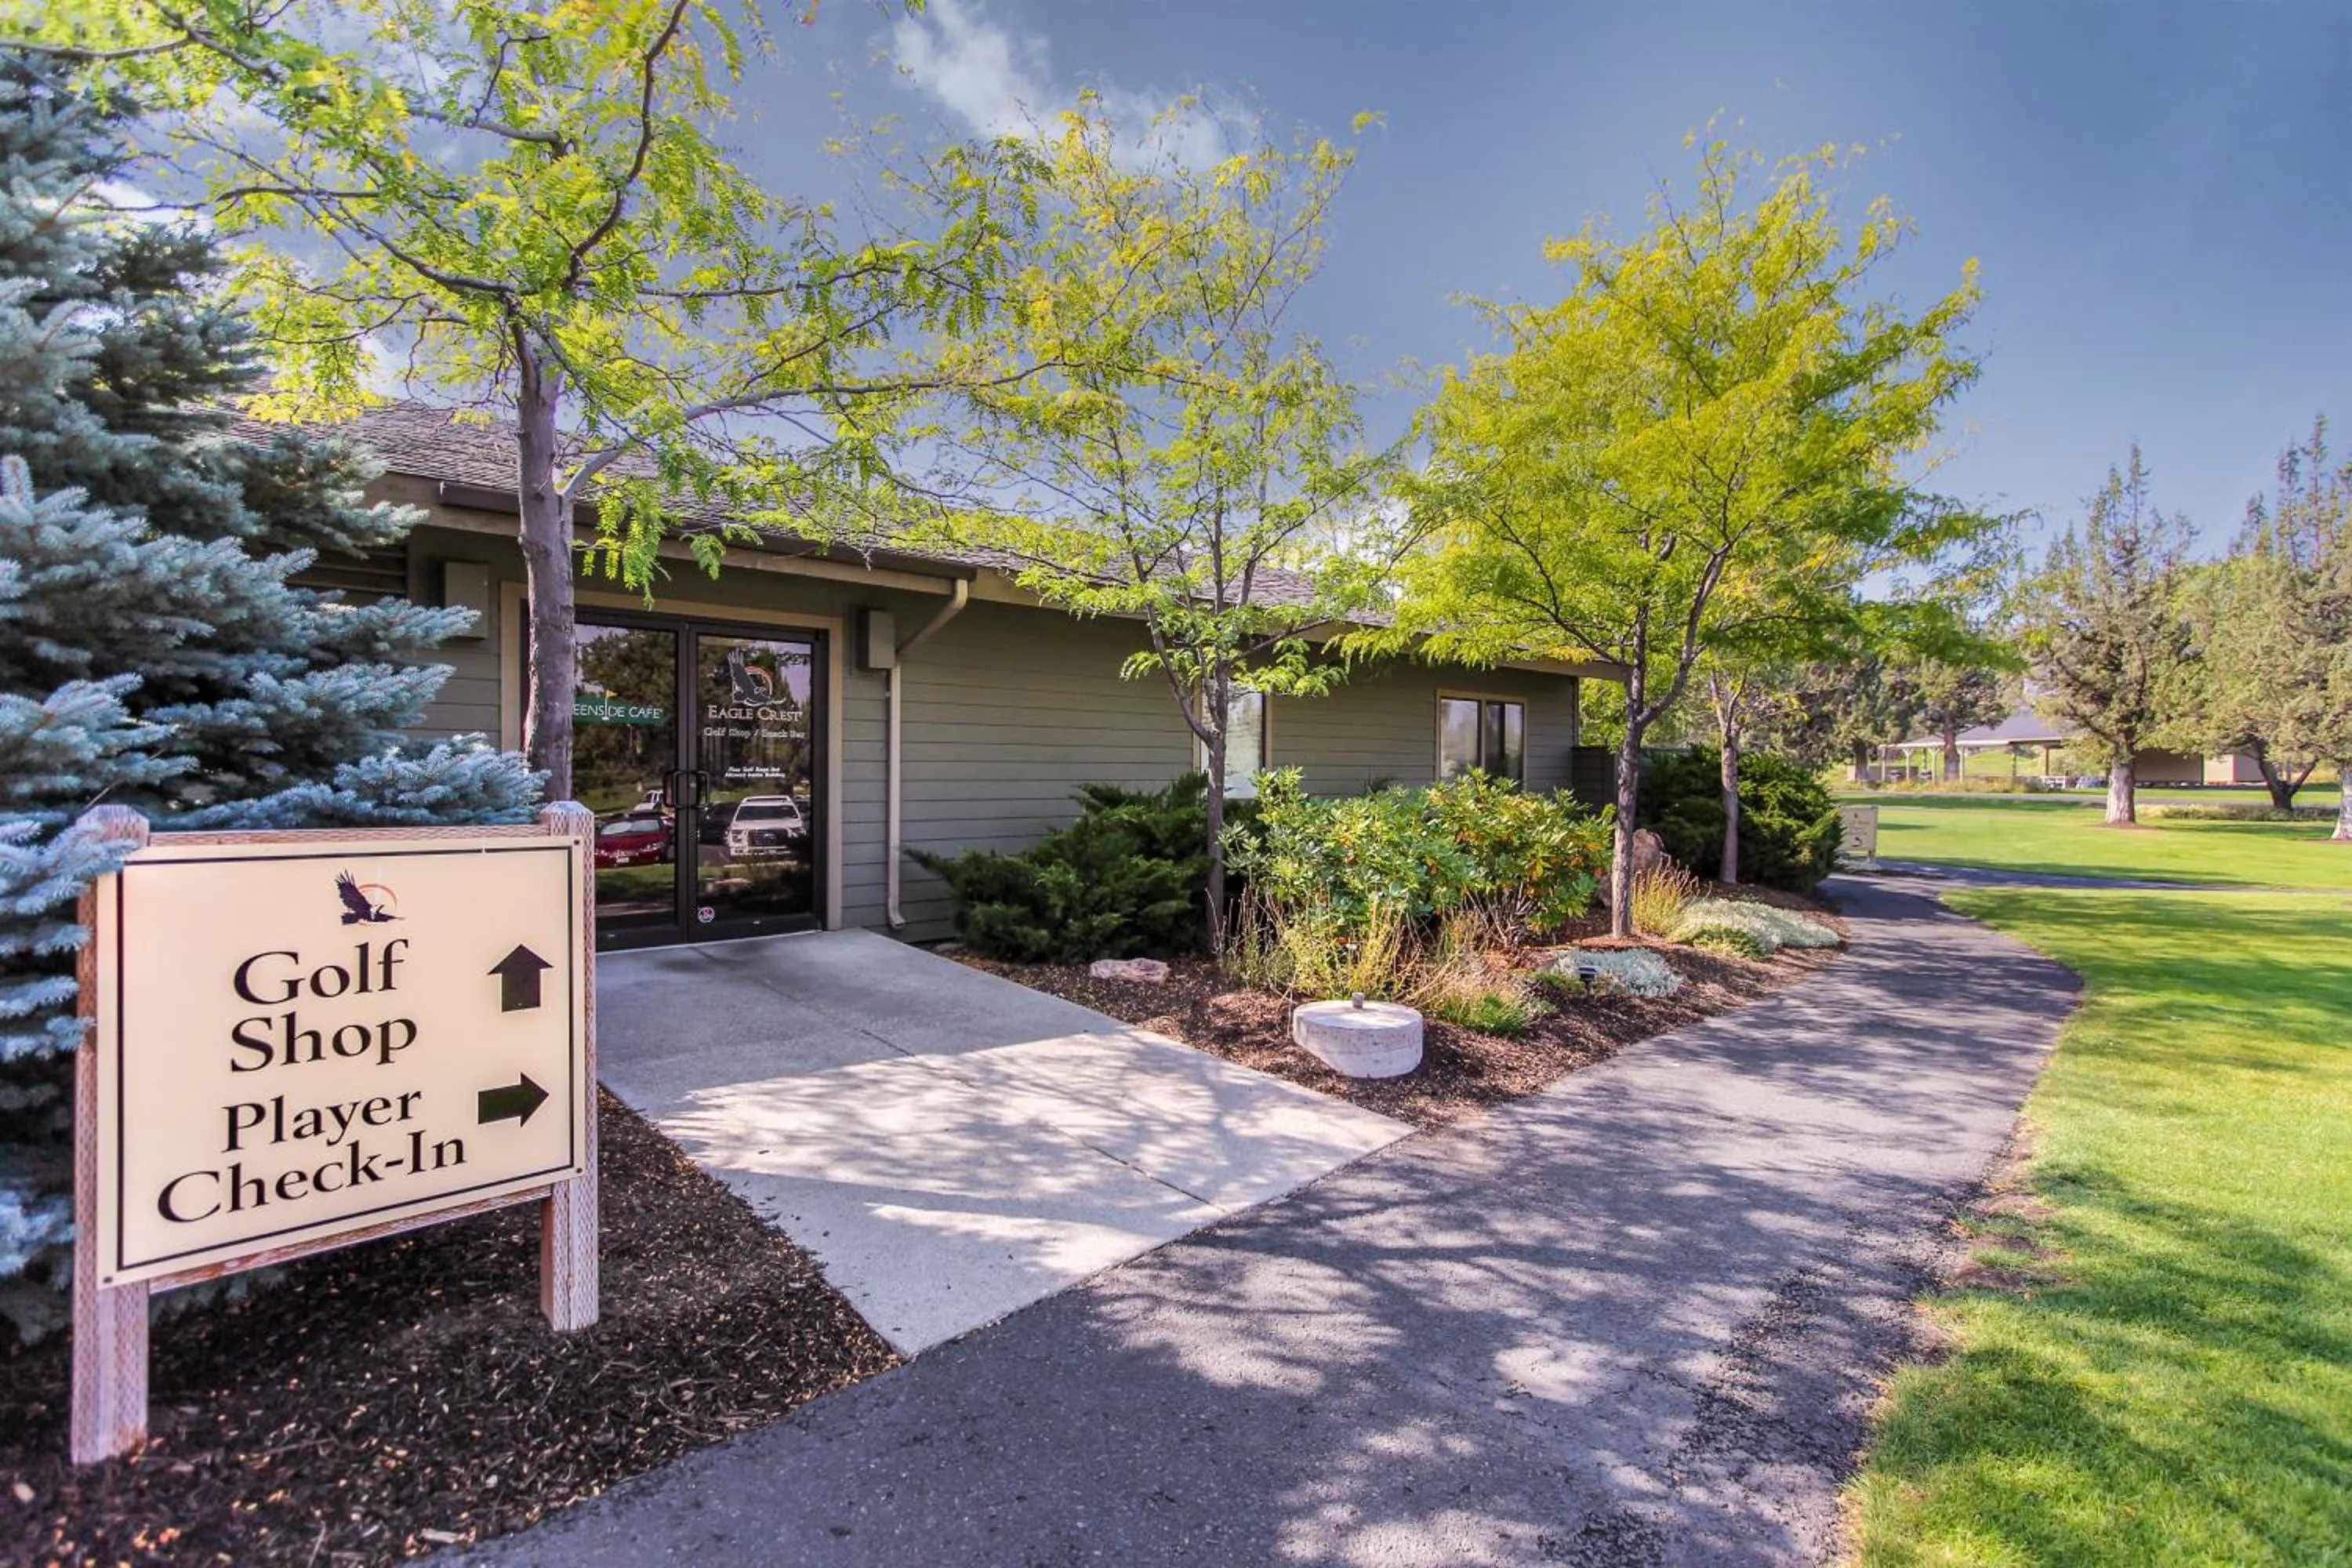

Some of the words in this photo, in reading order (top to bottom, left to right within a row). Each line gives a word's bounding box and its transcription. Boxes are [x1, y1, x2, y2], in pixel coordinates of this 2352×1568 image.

[573, 701, 625, 720] EENSIDE
[703, 727, 727, 736] Golf
[728, 727, 751, 739] Shop
[707, 705, 753, 720] EAGLE
[757, 706, 803, 721] CREST
[233, 938, 408, 1005] Golf
[230, 1011, 417, 1073] Shop
[221, 1091, 422, 1153] Player
[158, 1130, 467, 1223] Check-In
